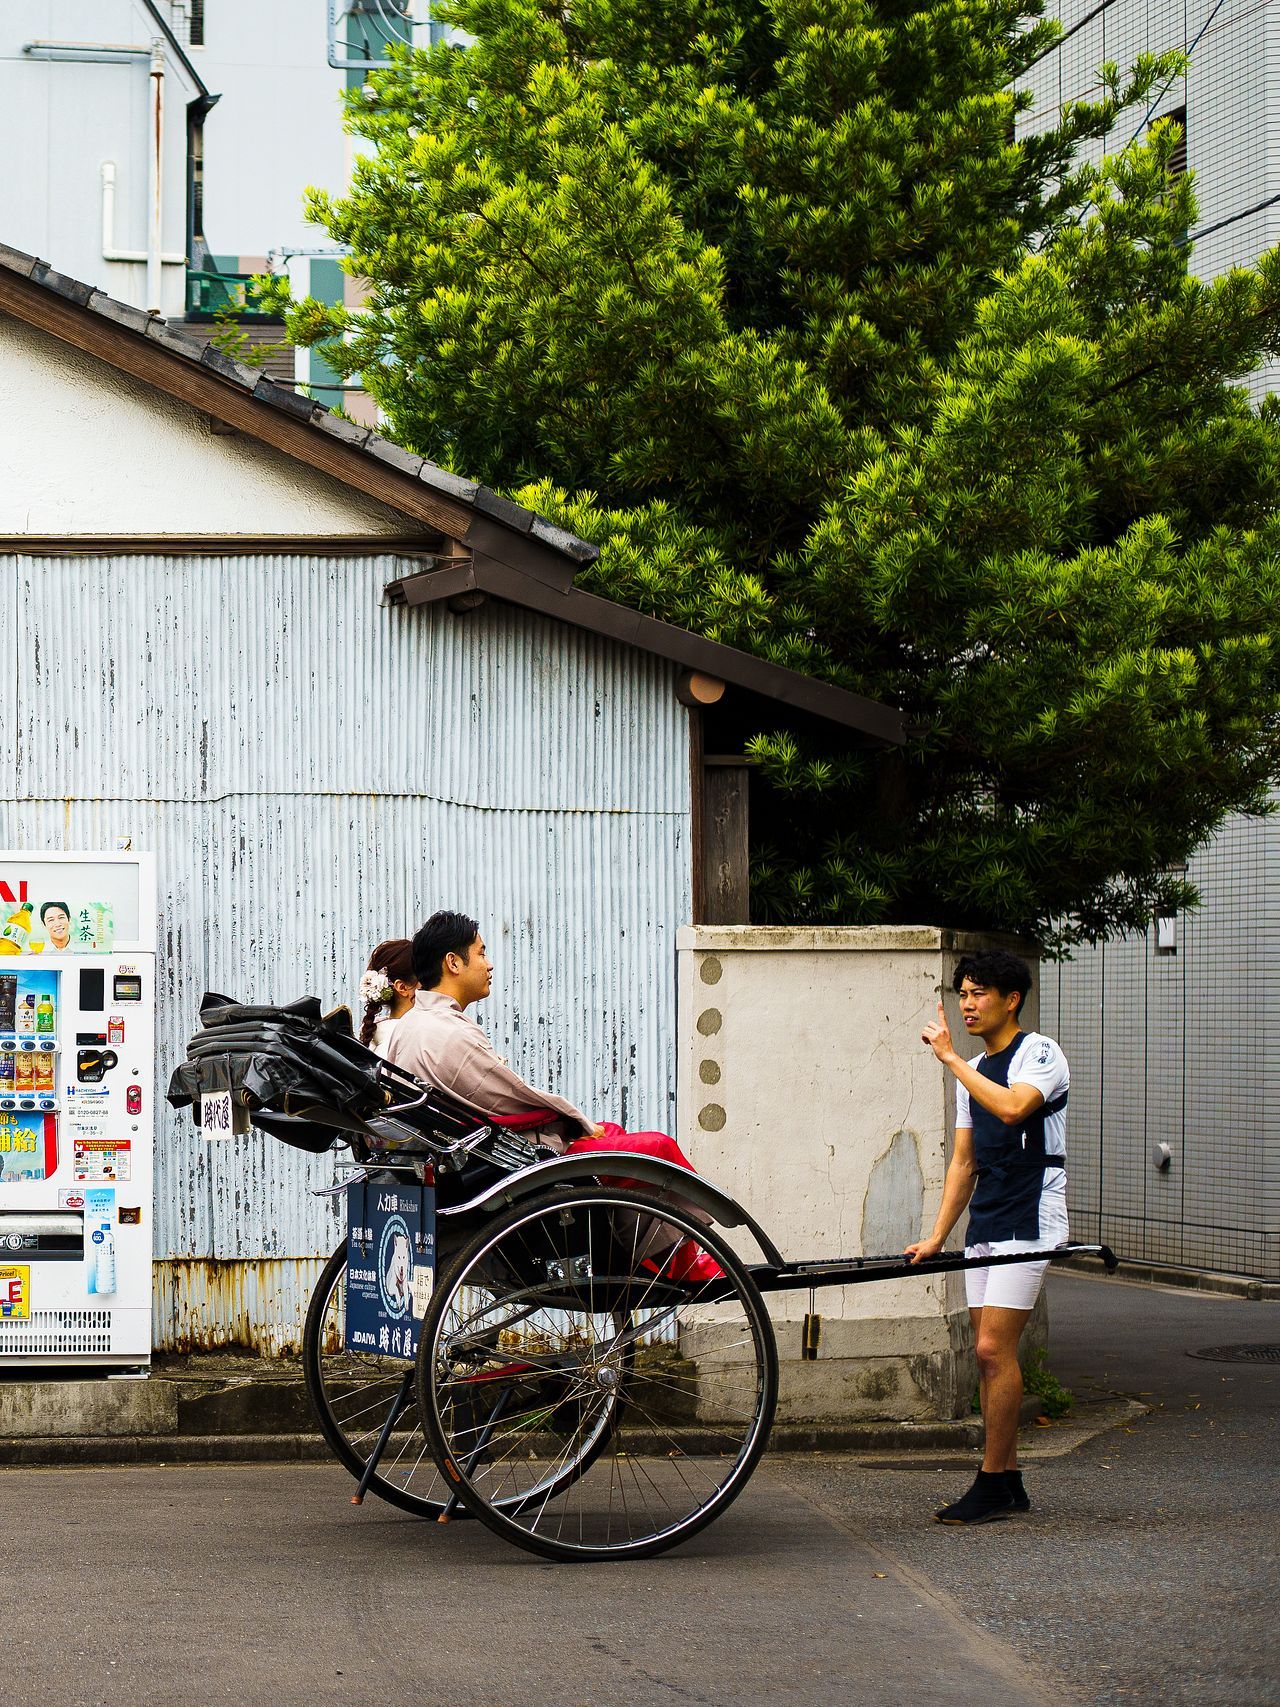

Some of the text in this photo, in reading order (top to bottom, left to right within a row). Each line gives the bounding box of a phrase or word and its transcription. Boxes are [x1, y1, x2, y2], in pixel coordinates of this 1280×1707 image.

[79, 908, 95, 942] 生茶
[377, 1192, 398, 1213] 人力車
[349, 1268, 377, 1282] 日本文化体験
[352, 1330, 376, 1346] JIDAIYA
